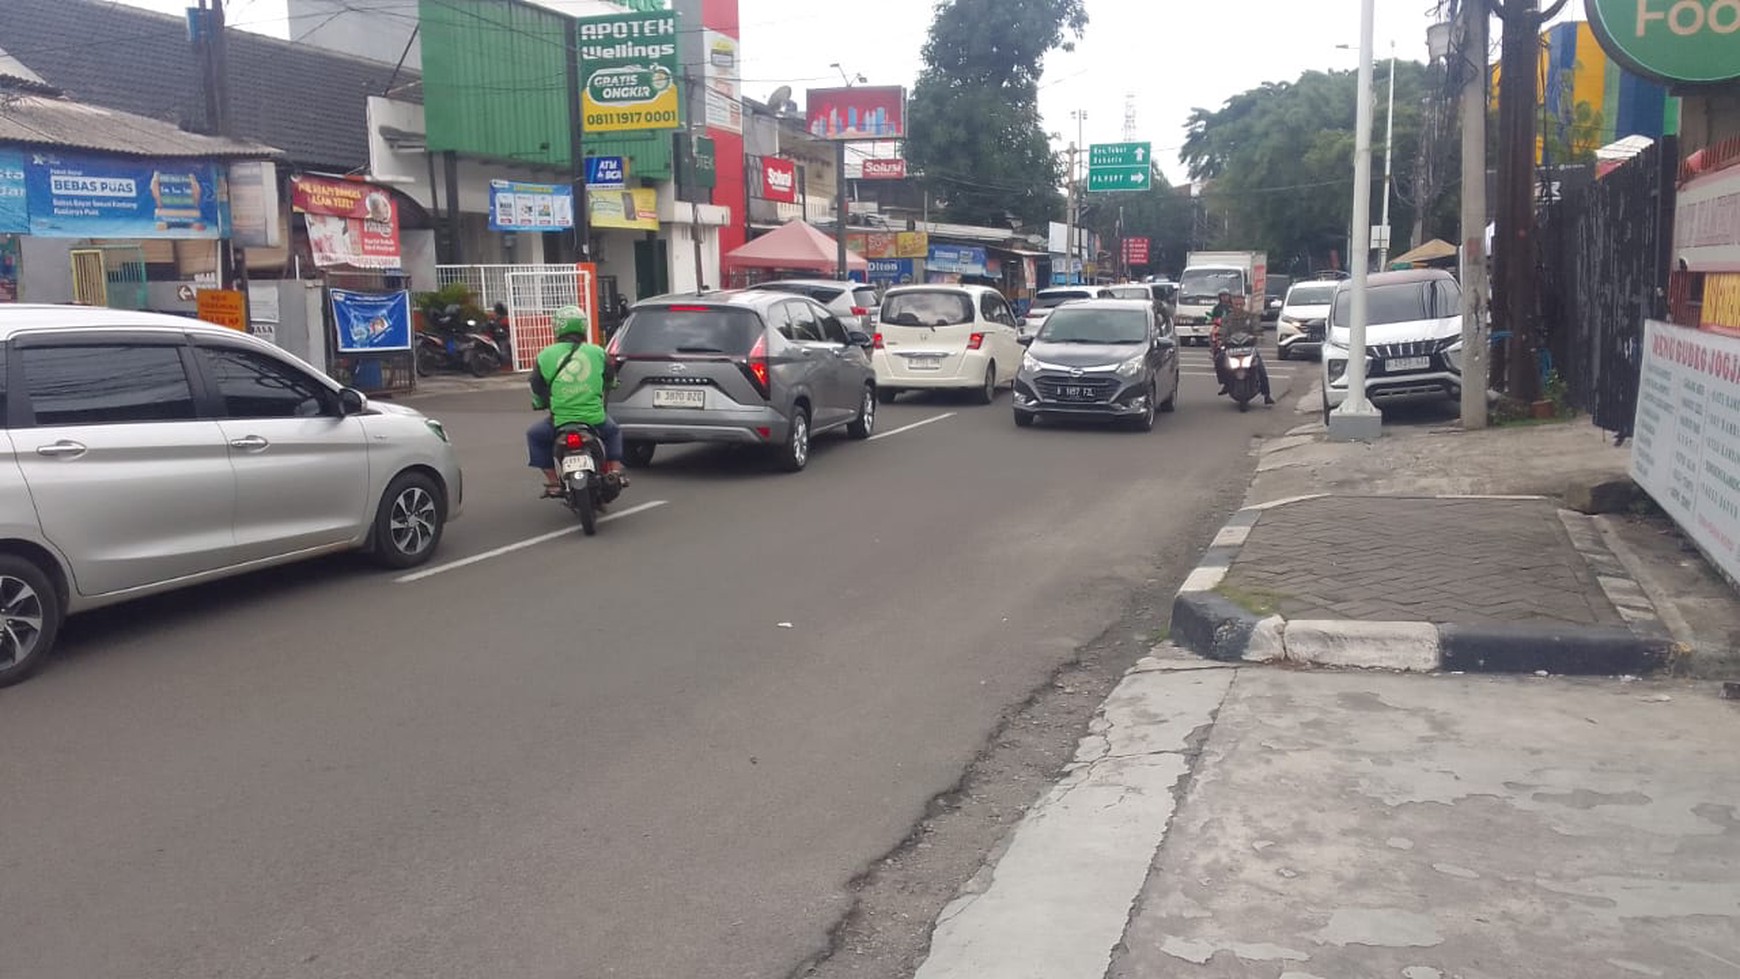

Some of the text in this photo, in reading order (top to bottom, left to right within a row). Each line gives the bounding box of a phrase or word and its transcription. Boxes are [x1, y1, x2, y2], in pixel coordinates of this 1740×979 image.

[581, 18, 674, 40] APOTEK
[582, 42, 675, 59] Wellings
[594, 75, 638, 86] GRATIS
[603, 87, 651, 99] ONGKIR
[587, 110, 676, 125] 0811 1917 0001
[599, 160, 617, 170] ATM
[605, 170, 622, 180] BCA
[53, 179, 134, 194] BEBAS PUAS
[1675, 339, 1708, 373] GUDEG
